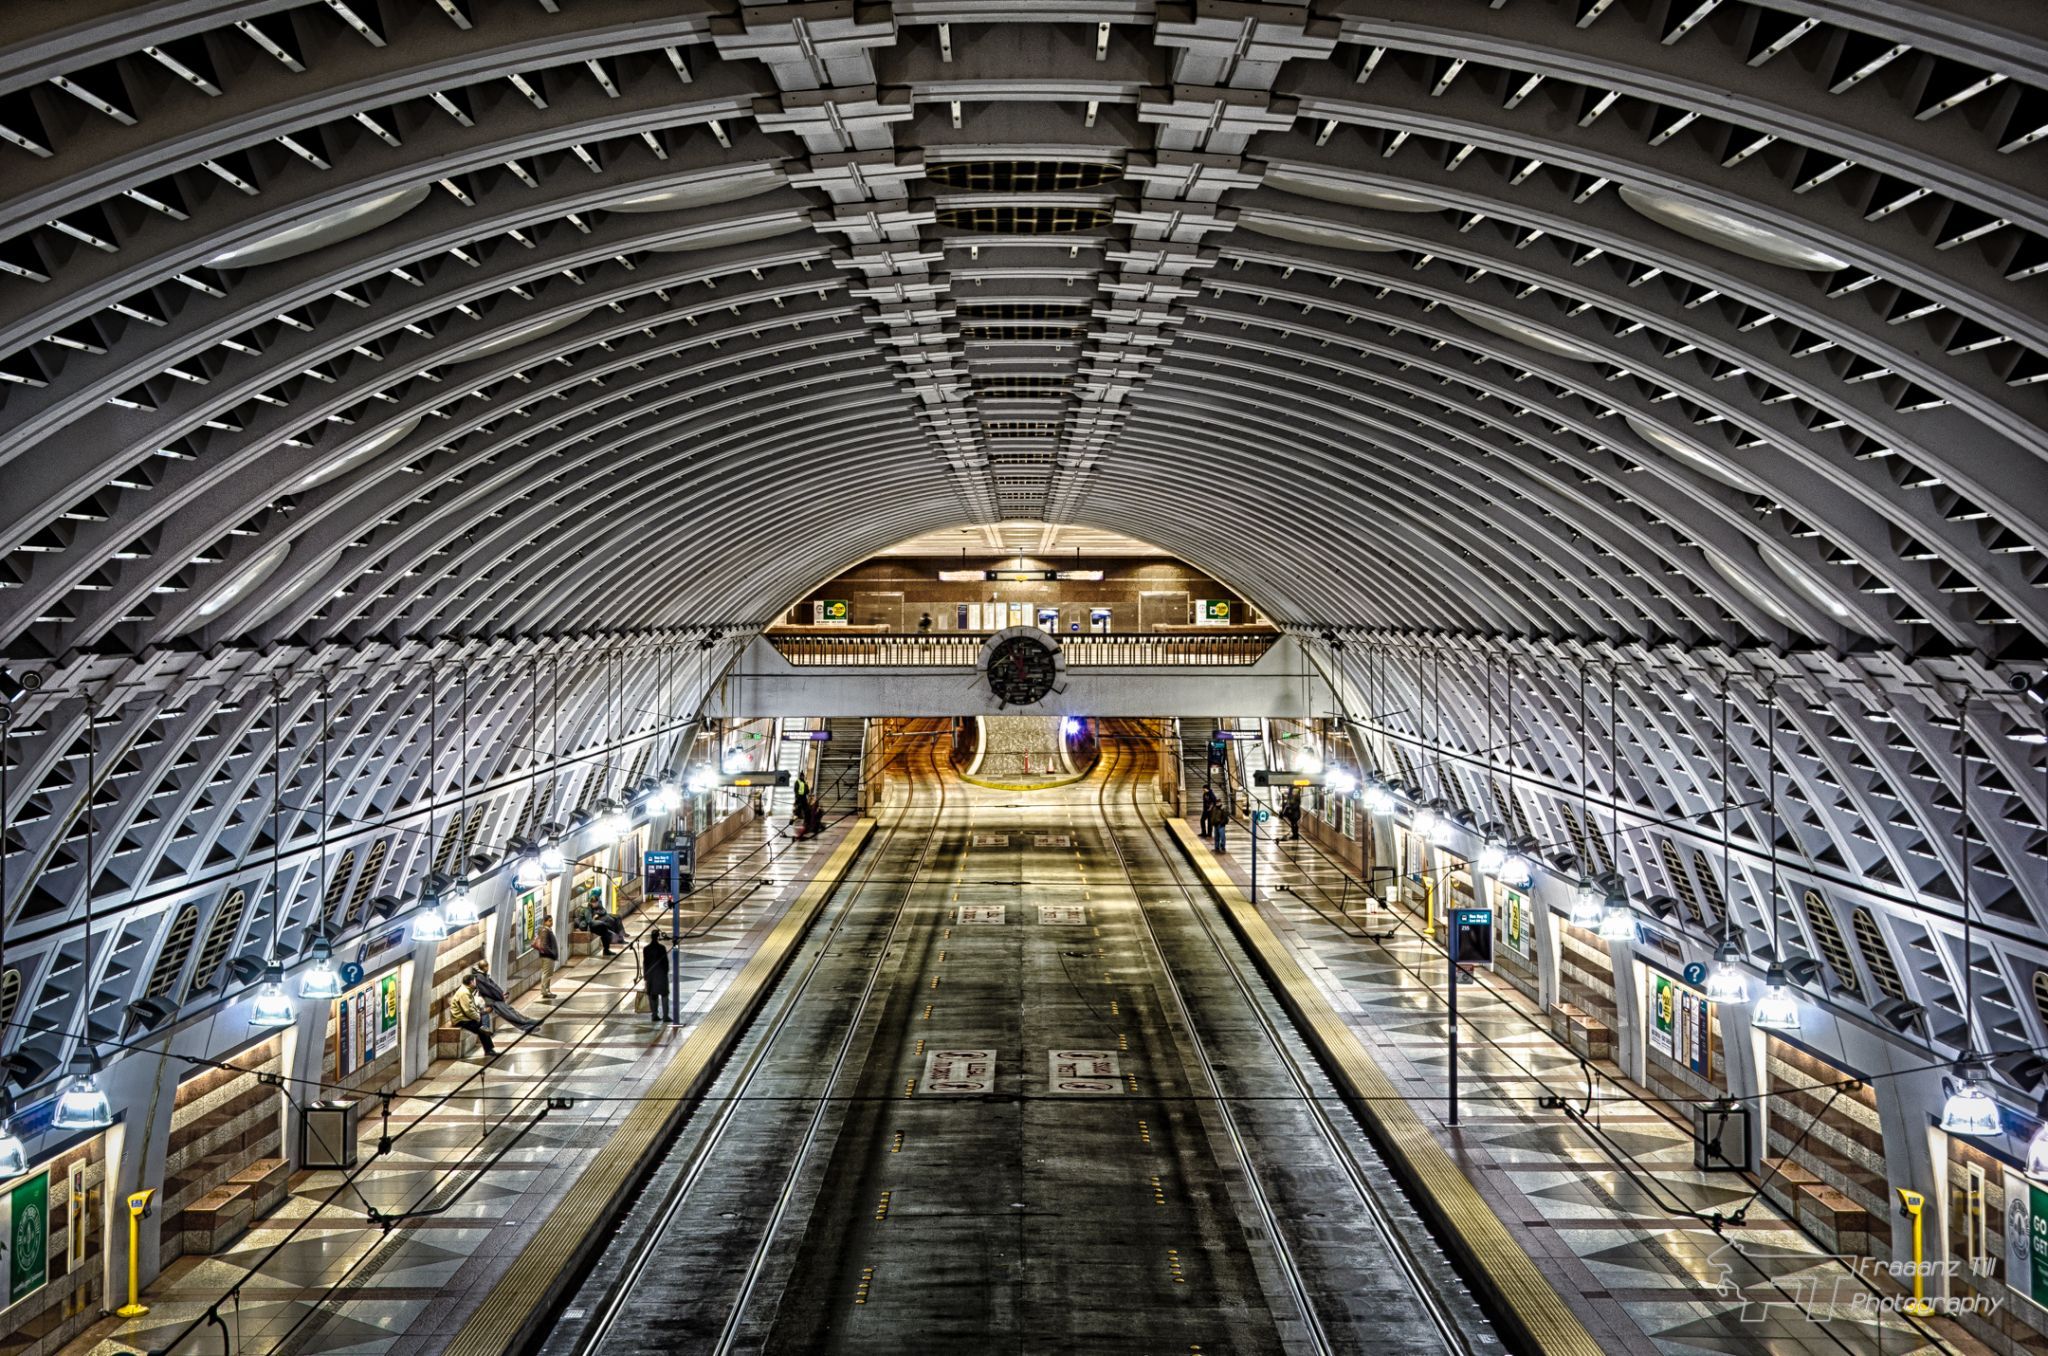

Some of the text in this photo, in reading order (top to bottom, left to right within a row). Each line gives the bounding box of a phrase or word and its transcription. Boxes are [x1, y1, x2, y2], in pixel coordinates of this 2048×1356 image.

[347, 965, 358, 982] ?
[1689, 965, 1700, 982] ?
[2033, 1214, 2047, 1236] GO
